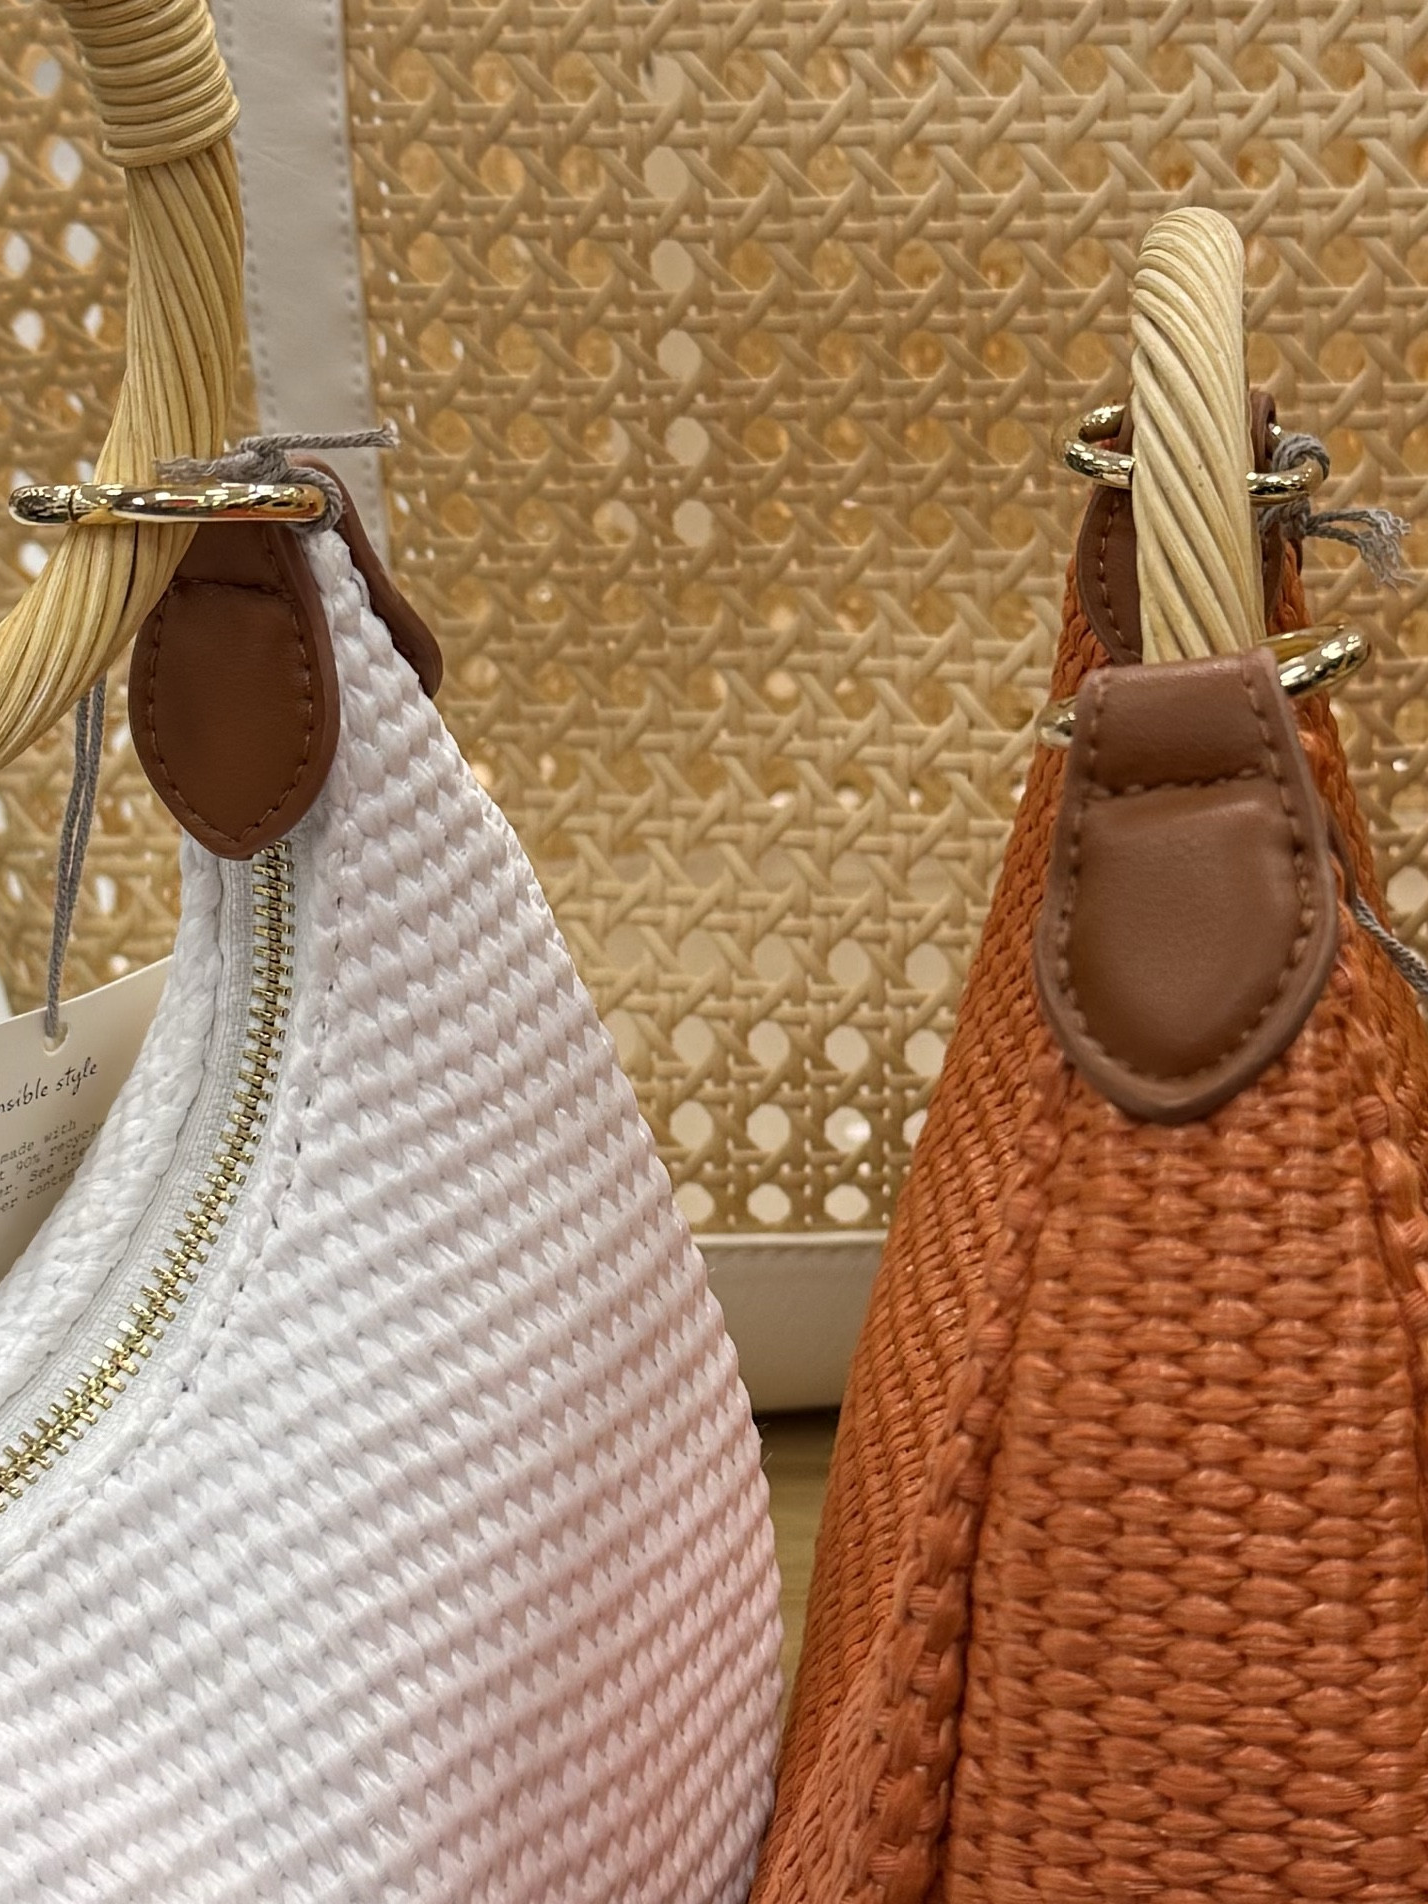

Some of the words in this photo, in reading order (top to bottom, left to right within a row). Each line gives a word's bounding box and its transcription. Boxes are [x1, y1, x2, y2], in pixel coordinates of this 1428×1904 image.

[55, 1056, 98, 1096] style
[0, 1141, 35, 1165] made
[44, 1119, 77, 1144] with
[16, 1153, 41, 1176] 90%
[29, 1163, 55, 1183] See
